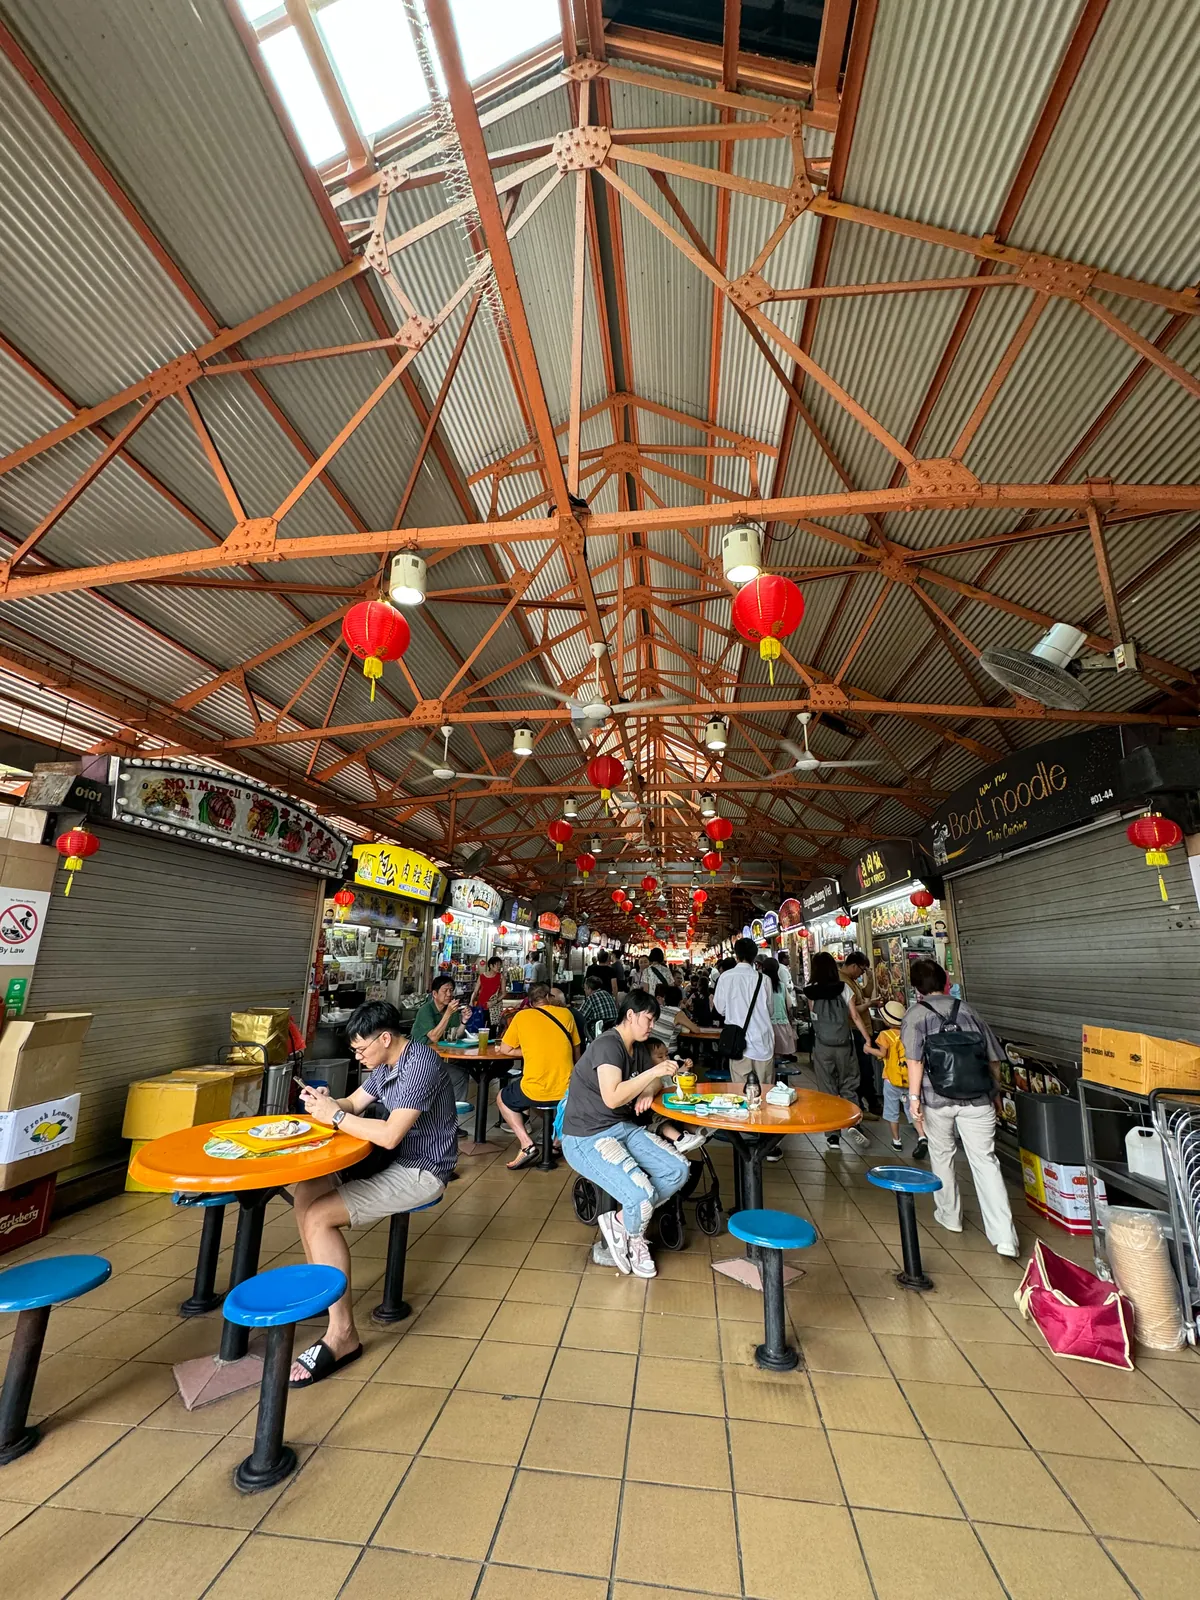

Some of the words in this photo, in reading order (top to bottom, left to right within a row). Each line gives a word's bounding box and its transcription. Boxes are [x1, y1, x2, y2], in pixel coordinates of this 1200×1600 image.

[75, 786, 102, 802] 0101
[163, 778, 195, 790] NO.1
[198, 780, 242, 799] Maxwell
[1090, 788, 1114, 805] #01-44
[948, 798, 990, 840] Boat
[991, 761, 1067, 820] noodle
[986, 829, 1002, 844] Thai
[1003, 820, 1028, 839] Cuisine
[9, 946, 25, 954] Law
[23, 1112, 49, 1134] Fresh
